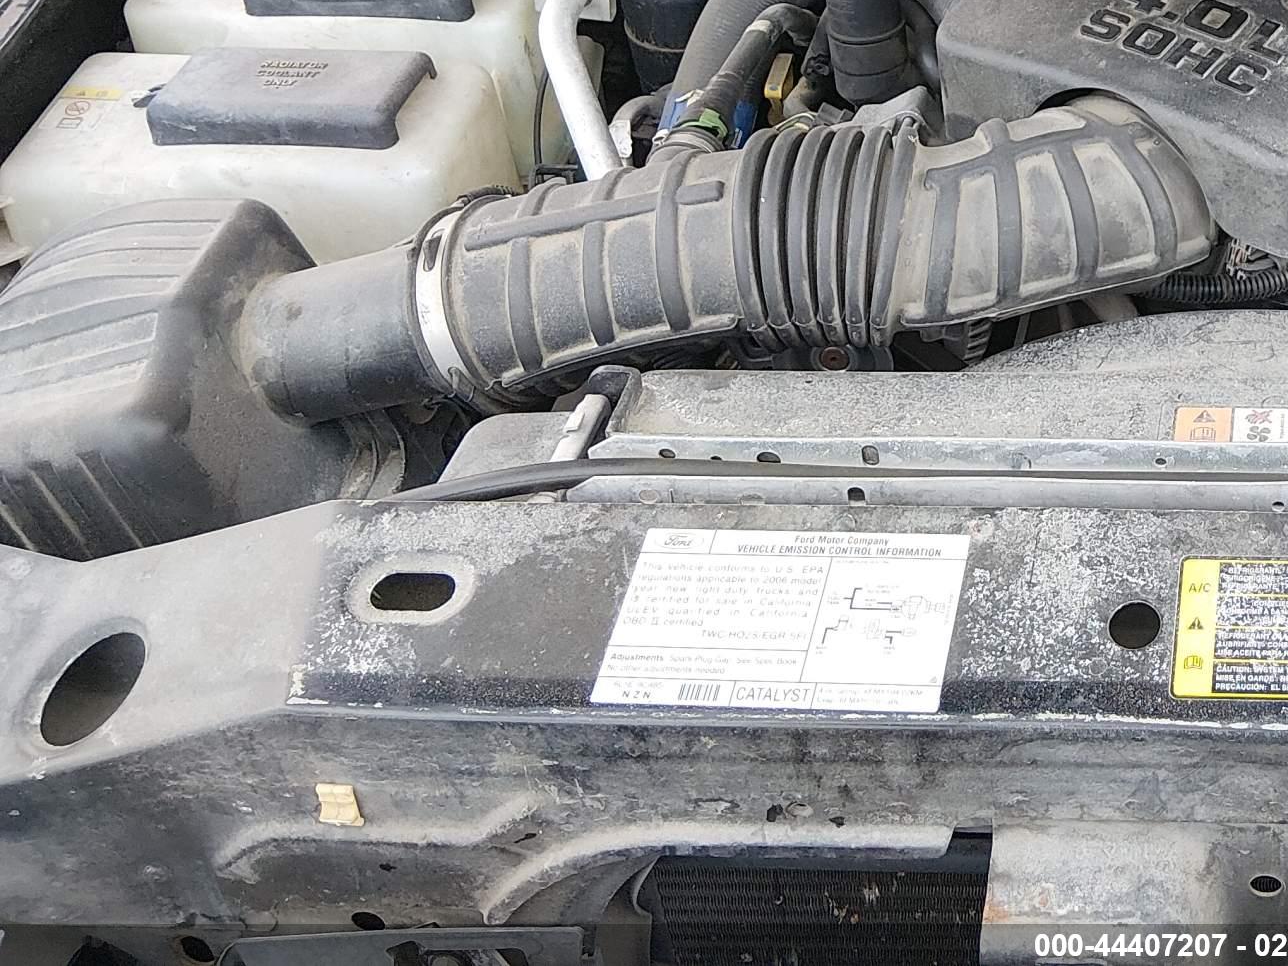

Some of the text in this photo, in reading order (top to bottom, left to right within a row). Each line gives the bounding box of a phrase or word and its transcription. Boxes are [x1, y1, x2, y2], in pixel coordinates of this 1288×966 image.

[1080, 7, 1271, 96] SOHC
[260, 60, 329, 70] RADIATOR
[255, 70, 321, 79] COOLANT
[263, 78, 298, 87] ONLY
[664, 534, 693, 547] Ford
[794, 535, 889, 546] Ford Motor Company
[737, 544, 942, 557] VEHICLE EMISSION CONTROL INFORMATION
[668, 562, 703, 571] vehicle
[802, 565, 824, 574] EPA
[763, 576, 788, 584] 2006
[790, 577, 822, 585] model
[1188, 583, 1211, 593] A/C
[1270, 683, 1281, 691] EL
[735, 686, 811, 702] CATALYST
